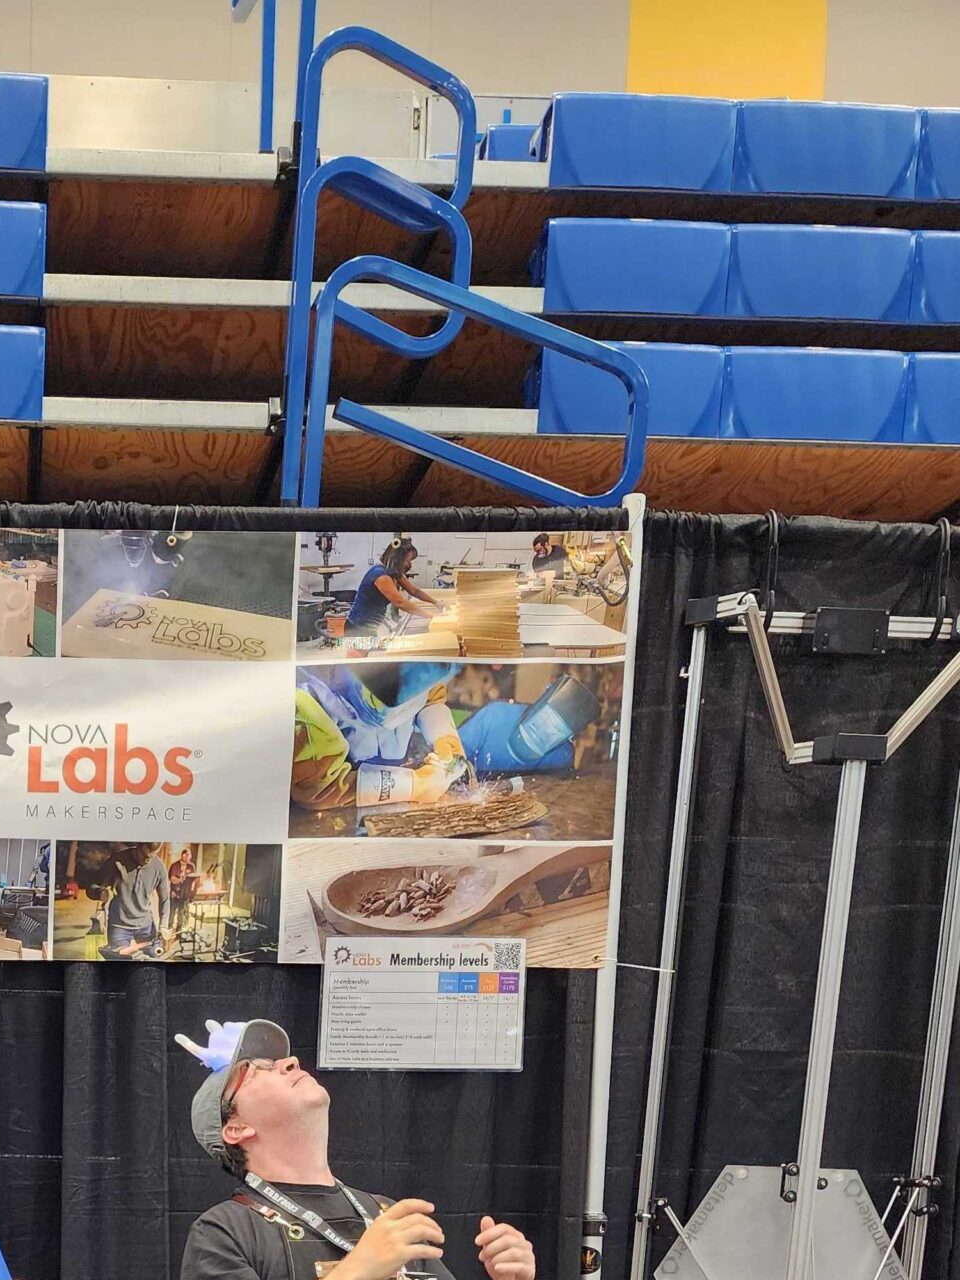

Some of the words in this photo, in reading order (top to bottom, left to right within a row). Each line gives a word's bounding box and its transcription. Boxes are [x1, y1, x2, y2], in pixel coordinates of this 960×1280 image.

[152, 622, 266, 657] Labs
[29, 724, 108, 744] NOVA
[26, 804, 191, 821] MAKERSPACE
[352, 955, 382, 966] Labs
[389, 952, 455, 969] Membership
[459, 953, 489, 967] levels
